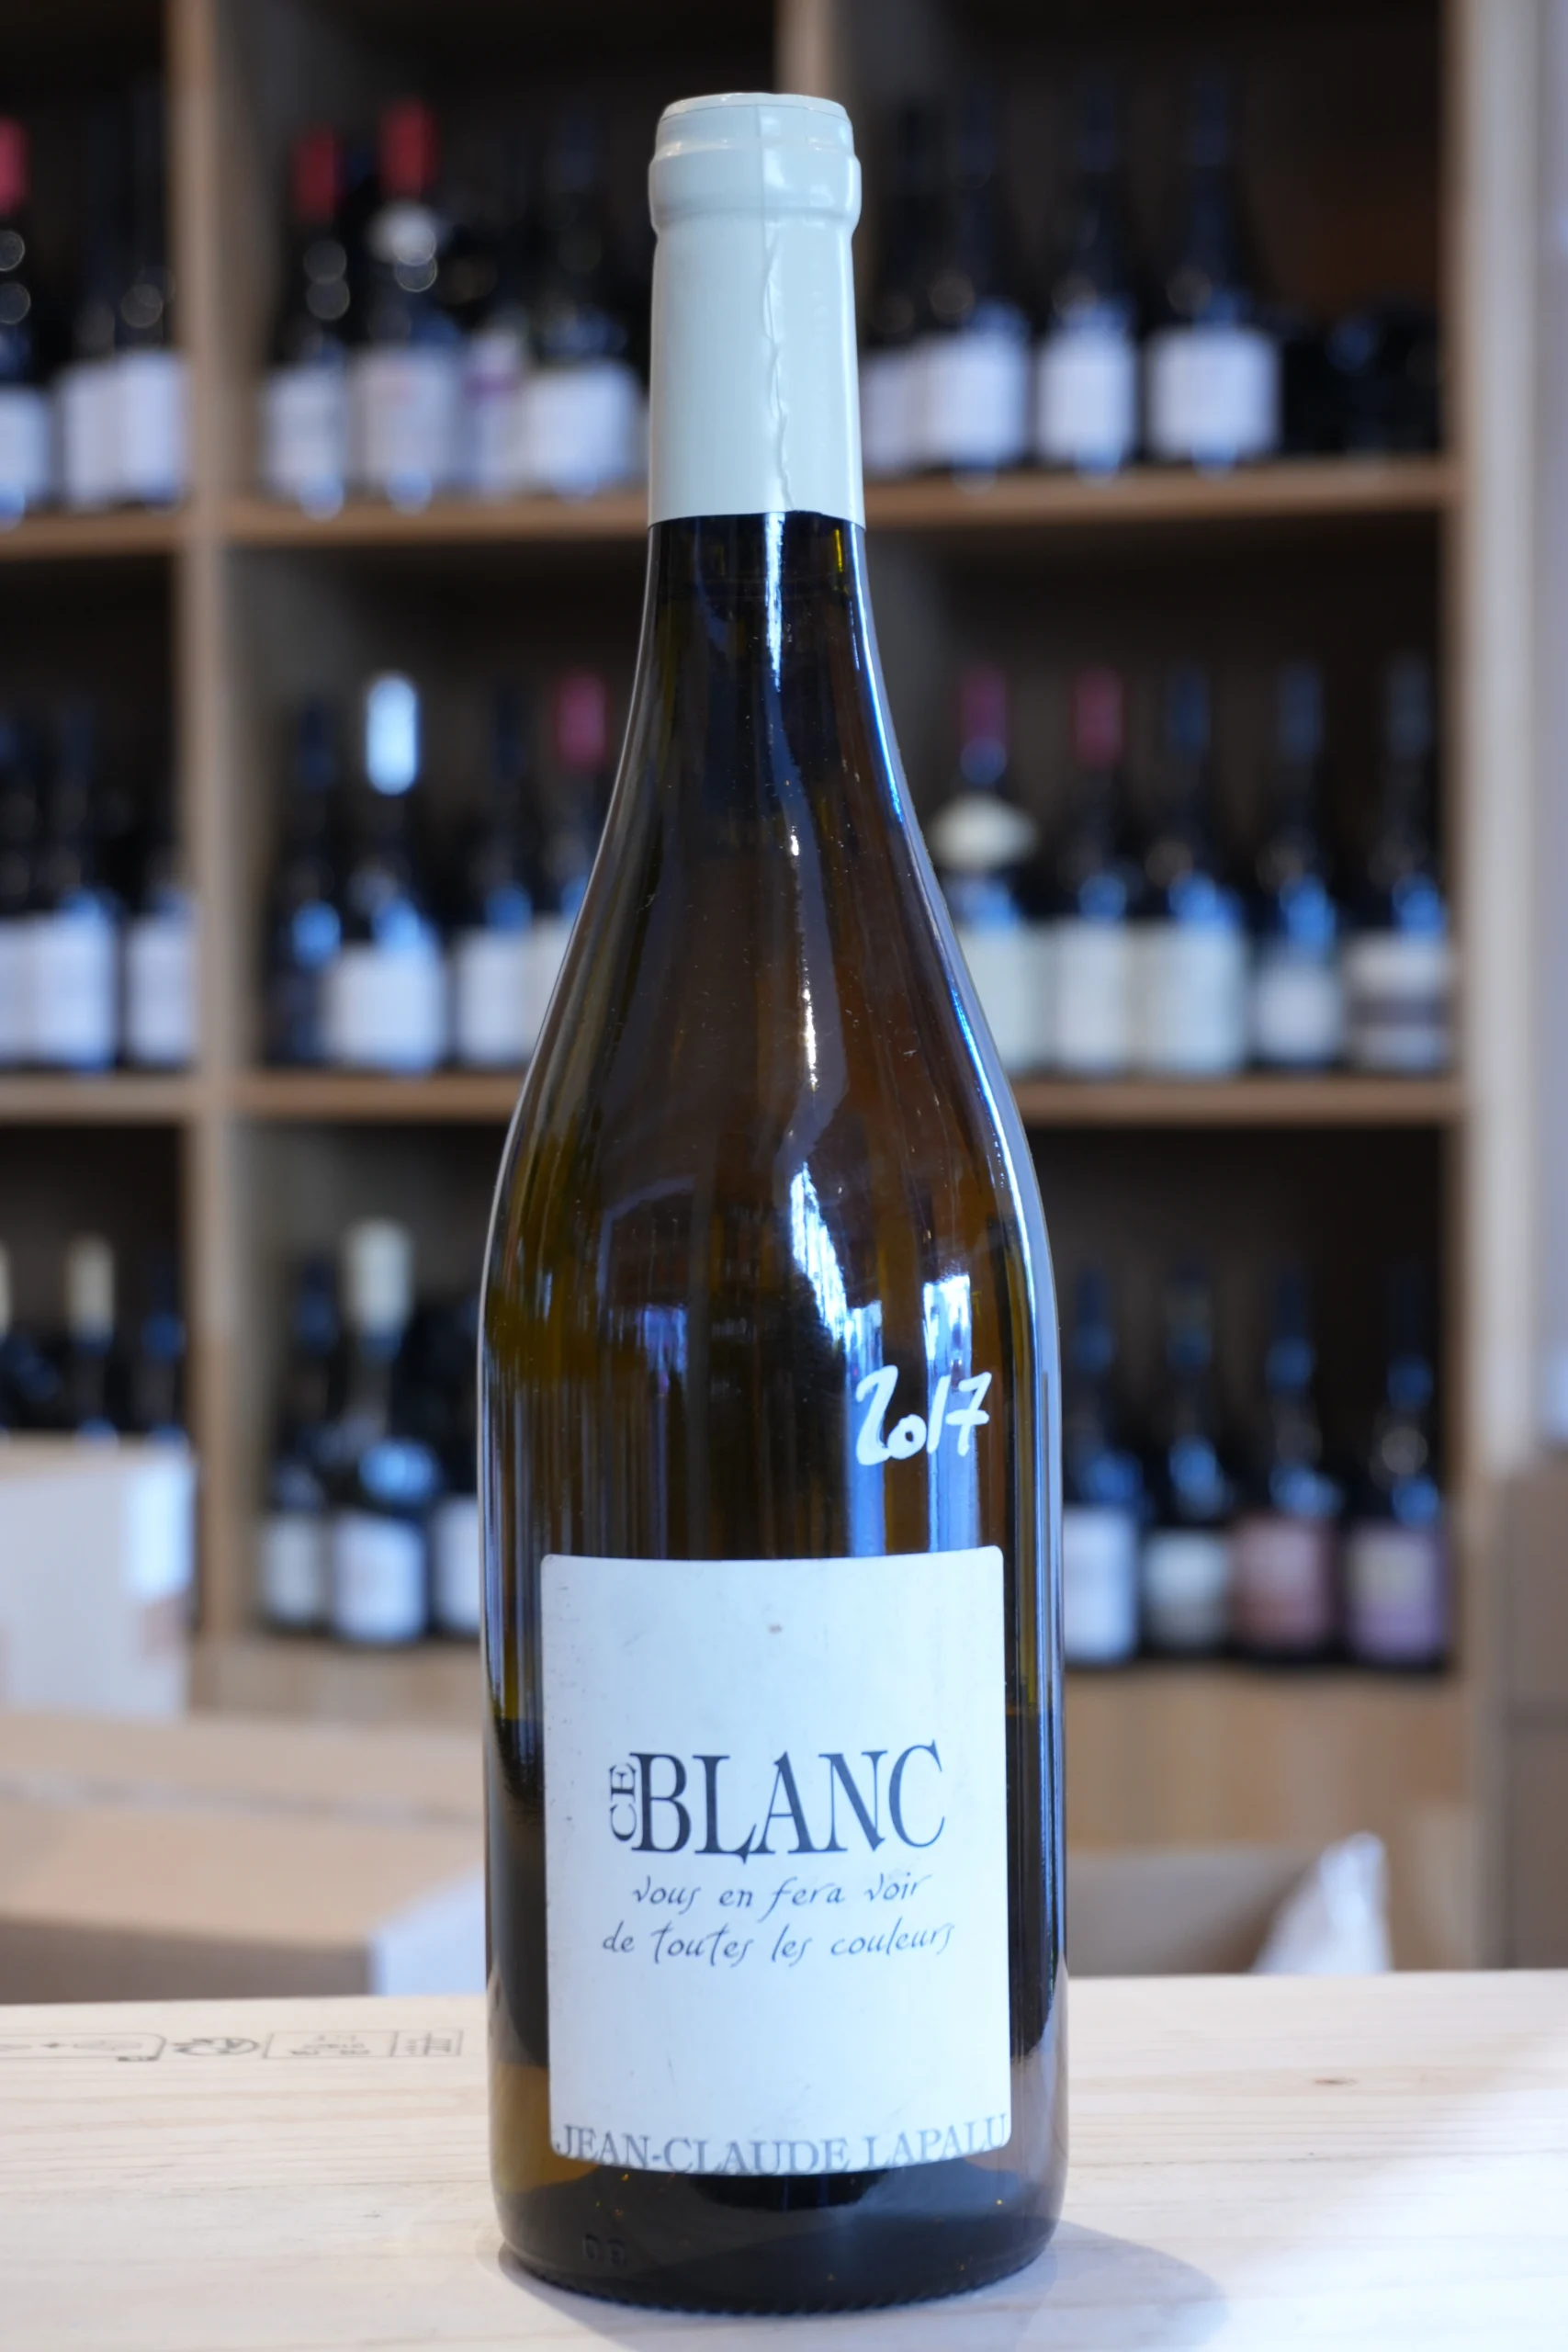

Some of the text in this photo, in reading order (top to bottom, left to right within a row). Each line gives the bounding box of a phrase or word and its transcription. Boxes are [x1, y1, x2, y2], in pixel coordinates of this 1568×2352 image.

[855, 1364, 992, 1465] 2017
[609, 1739, 945, 1865] CE BLANC
[632, 1871, 933, 1923] vous en fera voir
[602, 1917, 955, 1968] de toutes les couleurs
[557, 2113, 1008, 2175] JEAN-CLAUDE LAPALU
